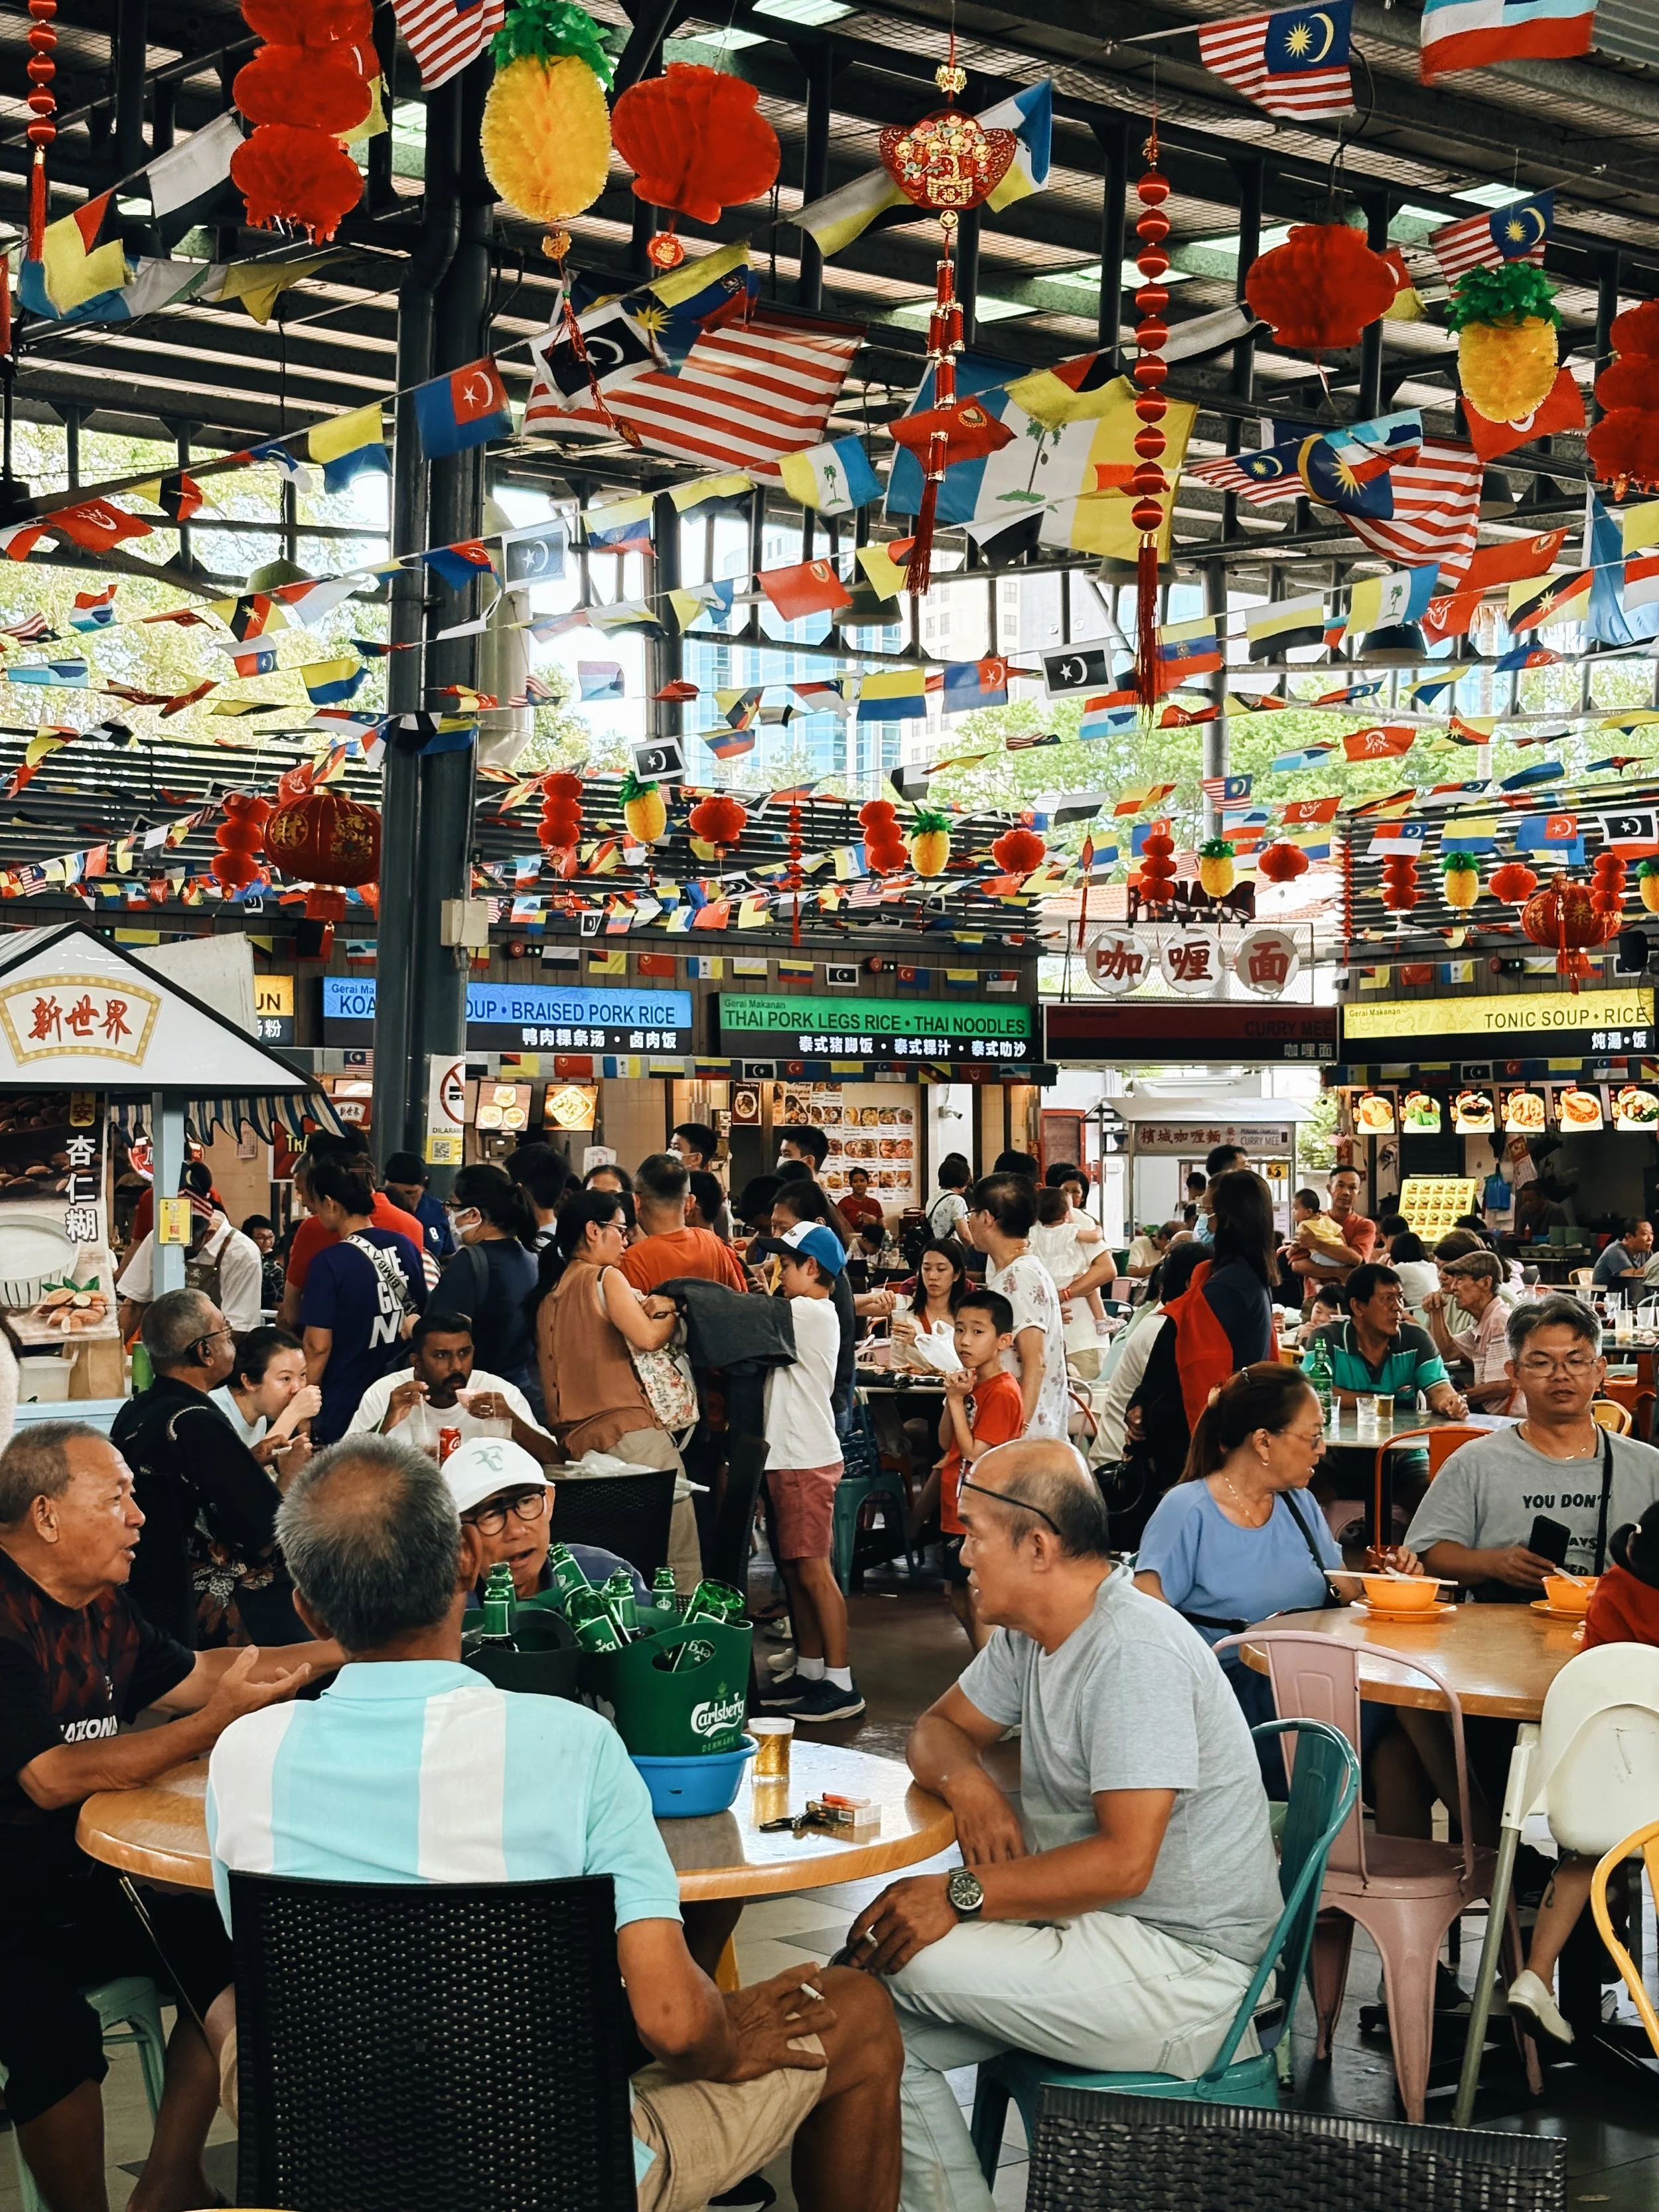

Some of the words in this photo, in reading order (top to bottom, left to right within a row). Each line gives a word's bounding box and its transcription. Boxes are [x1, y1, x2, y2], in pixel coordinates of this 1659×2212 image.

[1096, 940, 1289, 984] 咖喱面
[332, 984, 357, 994] Gerai
[360, 985, 374, 994] Ma
[340, 995, 376, 1015] KOA
[512, 1002, 584, 1021] BRAISED
[589, 1004, 634, 1024] PORK
[639, 1006, 676, 1025] RICE
[725, 999, 747, 1008] Gerai
[749, 1000, 786, 1009] Makanan
[1349, 1008, 1368, 1017] Gerai
[1370, 1007, 1401, 1017] Makanan
[29, 994, 132, 1045] 新世界
[725, 1010, 763, 1027] THAI
[768, 1011, 814, 1028] PORK
[818, 1013, 861, 1029] LEGS
[865, 1014, 901, 1031] RICE
[914, 1015, 949, 1033] THAI
[953, 1017, 1025, 1035] NOODLES
[1484, 1011, 1536, 1029] TONIC
[1542, 1009, 1589, 1027] SOUP
[1605, 1007, 1646, 1024] RICE
[1245, 1020, 1297, 1037] CURRY
[1301, 1020, 1333, 1037] MEE
[522, 1028, 605, 1047] 鸭肉粿条汤
[630, 1031, 677, 1049] 卤肉饭
[799, 1035, 873, 1054] 泰式猪脚饭
[894, 1038, 952, 1056] 泰式粿汁
[972, 1040, 1027, 1058] 泰式叻沙
[1632, 1031, 1646, 1049] 饭
[1240, 1136, 1263, 1145] CURRY
[1265, 1136, 1280, 1145] MEE
[65, 1135, 98, 1242] 杏仁糊
[429, 1226, 439, 1240] 8
[1522, 1495, 1555, 1509] YOU
[1569, 1537, 1598, 1550] AYS
[691, 1696, 745, 1735] Carlsberg
